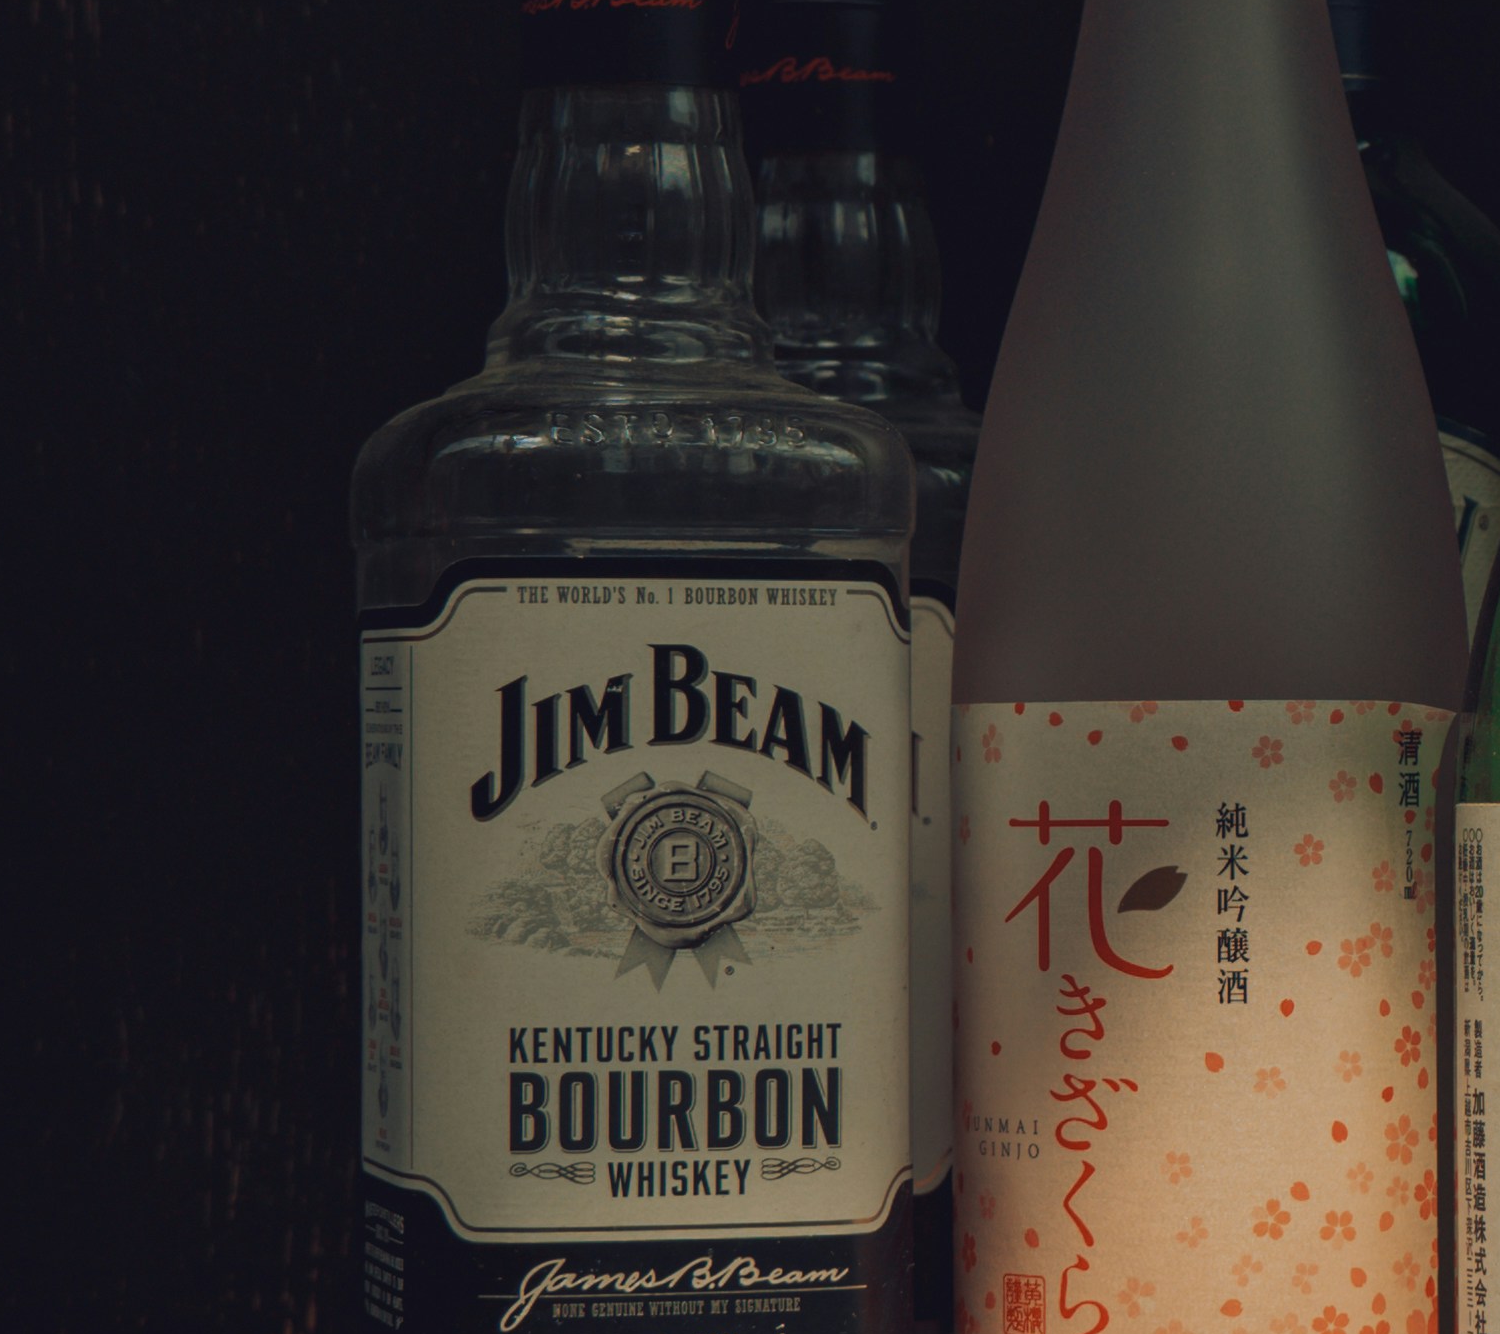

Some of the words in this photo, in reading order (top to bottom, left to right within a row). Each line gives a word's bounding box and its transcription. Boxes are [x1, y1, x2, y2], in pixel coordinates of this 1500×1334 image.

[517, 586, 549, 604] THE
[556, 586, 627, 604] WORLD'S
[634, 587, 661, 604] No.
[667, 587, 674, 604] 1
[684, 586, 758, 605] BOURBON
[766, 586, 838, 605] WHISKEY
[471, 673, 634, 822] JIM
[648, 643, 871, 823] BEAM
[1397, 730, 1422, 808] 清酒
[632, 813, 664, 851] JIM
[671, 808, 729, 852] BEAM
[663, 842, 699, 882] B
[630, 866, 684, 912] SINCE
[694, 867, 731, 910] 1795
[1215, 802, 1251, 1005] 純米吟醸酒
[509, 1025, 678, 1063] KENTUCKY
[694, 1023, 842, 1060] STRAIGHT
[509, 1067, 842, 1153] BOURBON
[979, 1140, 1040, 1159] GINJO
[609, 1159, 751, 1197] WHISKEY
[716, 1256, 849, 1289] Beam
[552, 1301, 586, 1319] NONE
[591, 1300, 645, 1318] GENUINE
[648, 1299, 704, 1317] WITHOUT
[710, 1299, 729, 1315] MY
[734, 1297, 801, 1314] SIGNATURE
